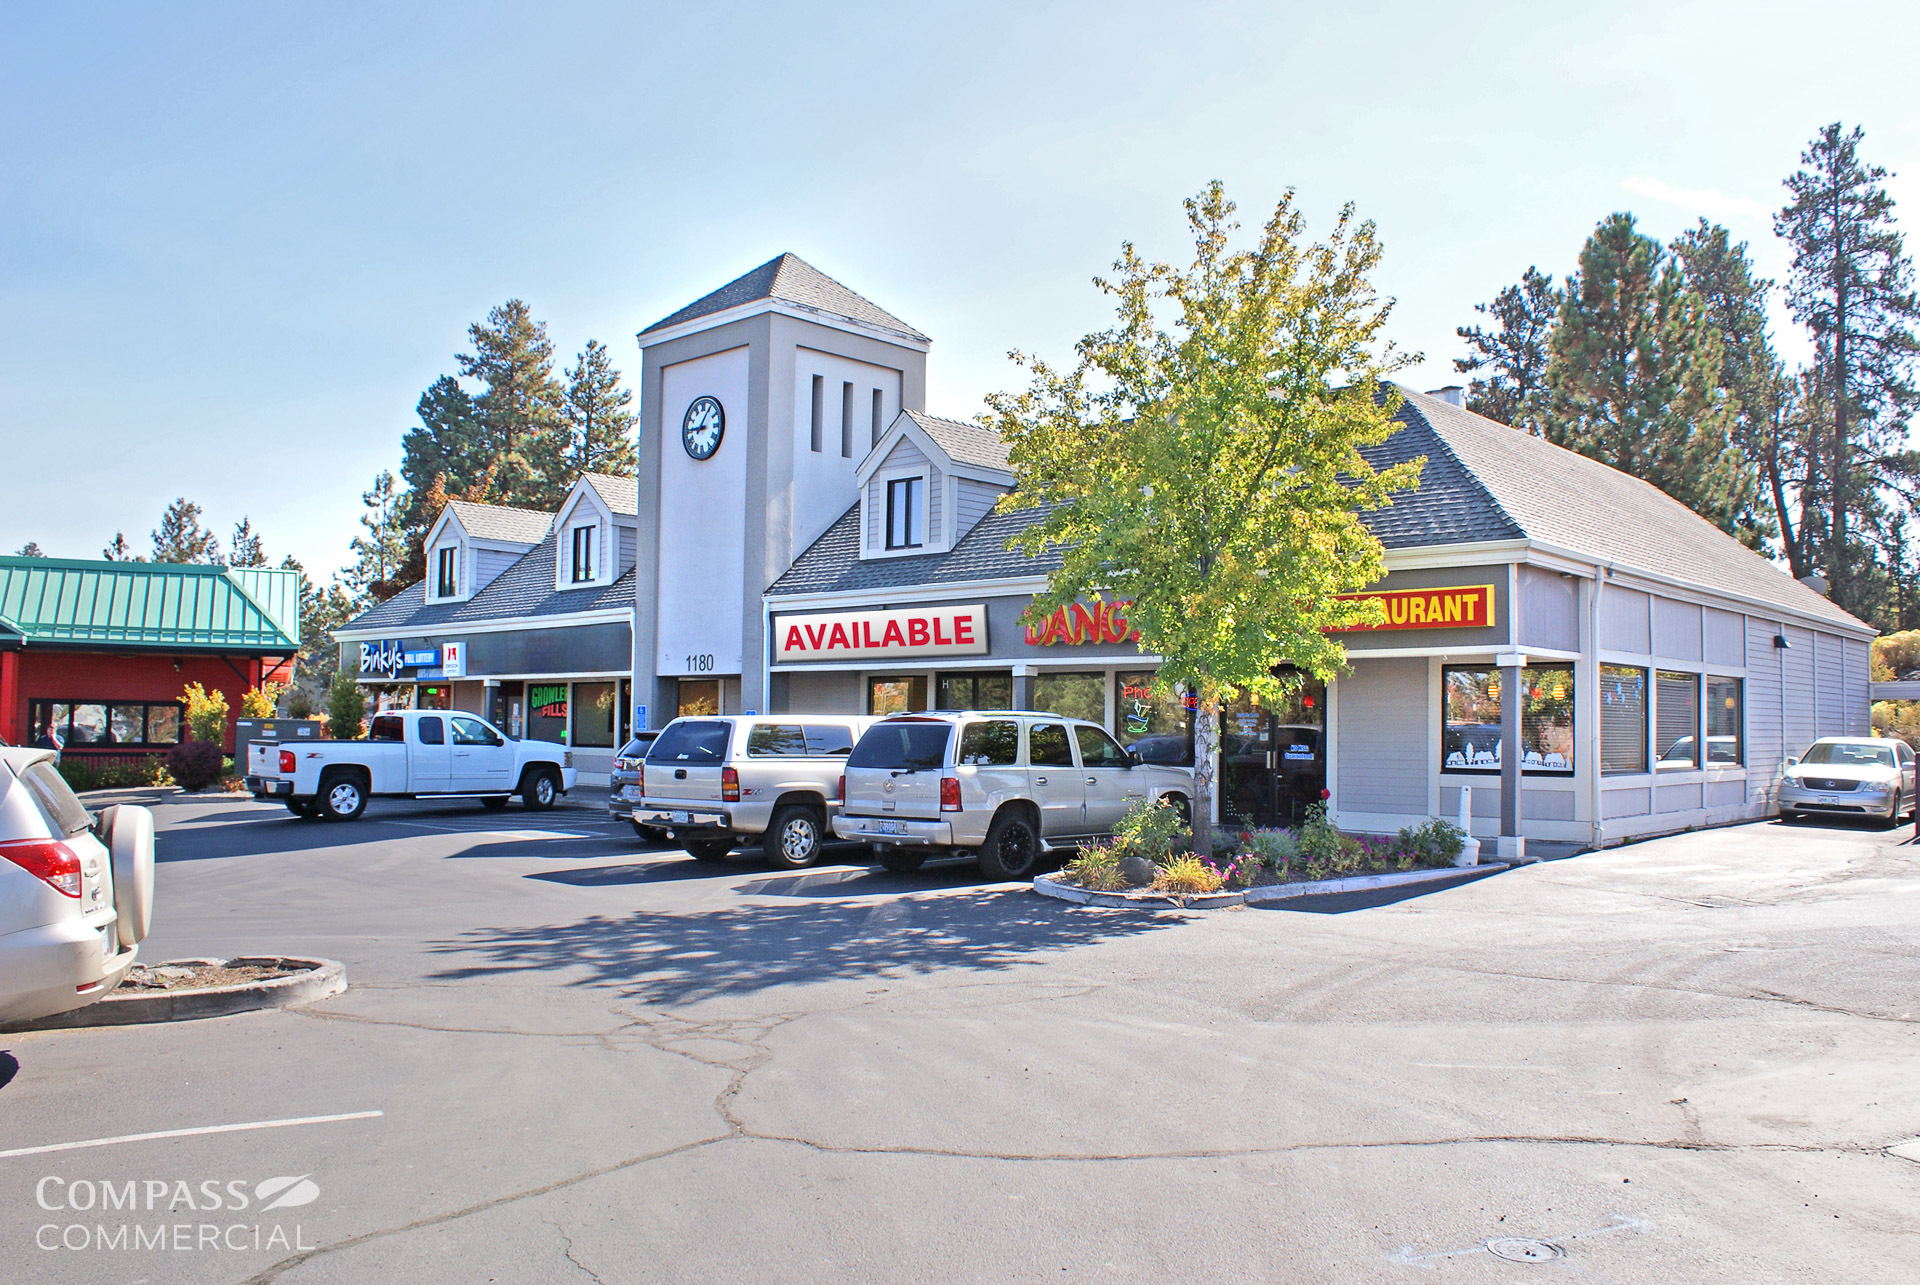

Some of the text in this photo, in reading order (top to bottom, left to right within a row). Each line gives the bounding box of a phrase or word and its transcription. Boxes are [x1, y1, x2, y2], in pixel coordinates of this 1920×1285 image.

[785, 615, 975, 651] AVAILABLE
[1022, 600, 1141, 646] DANG
[360, 640, 405, 680] Binky's
[686, 654, 714, 671] 1180
[542, 703, 568, 717] FILLS
